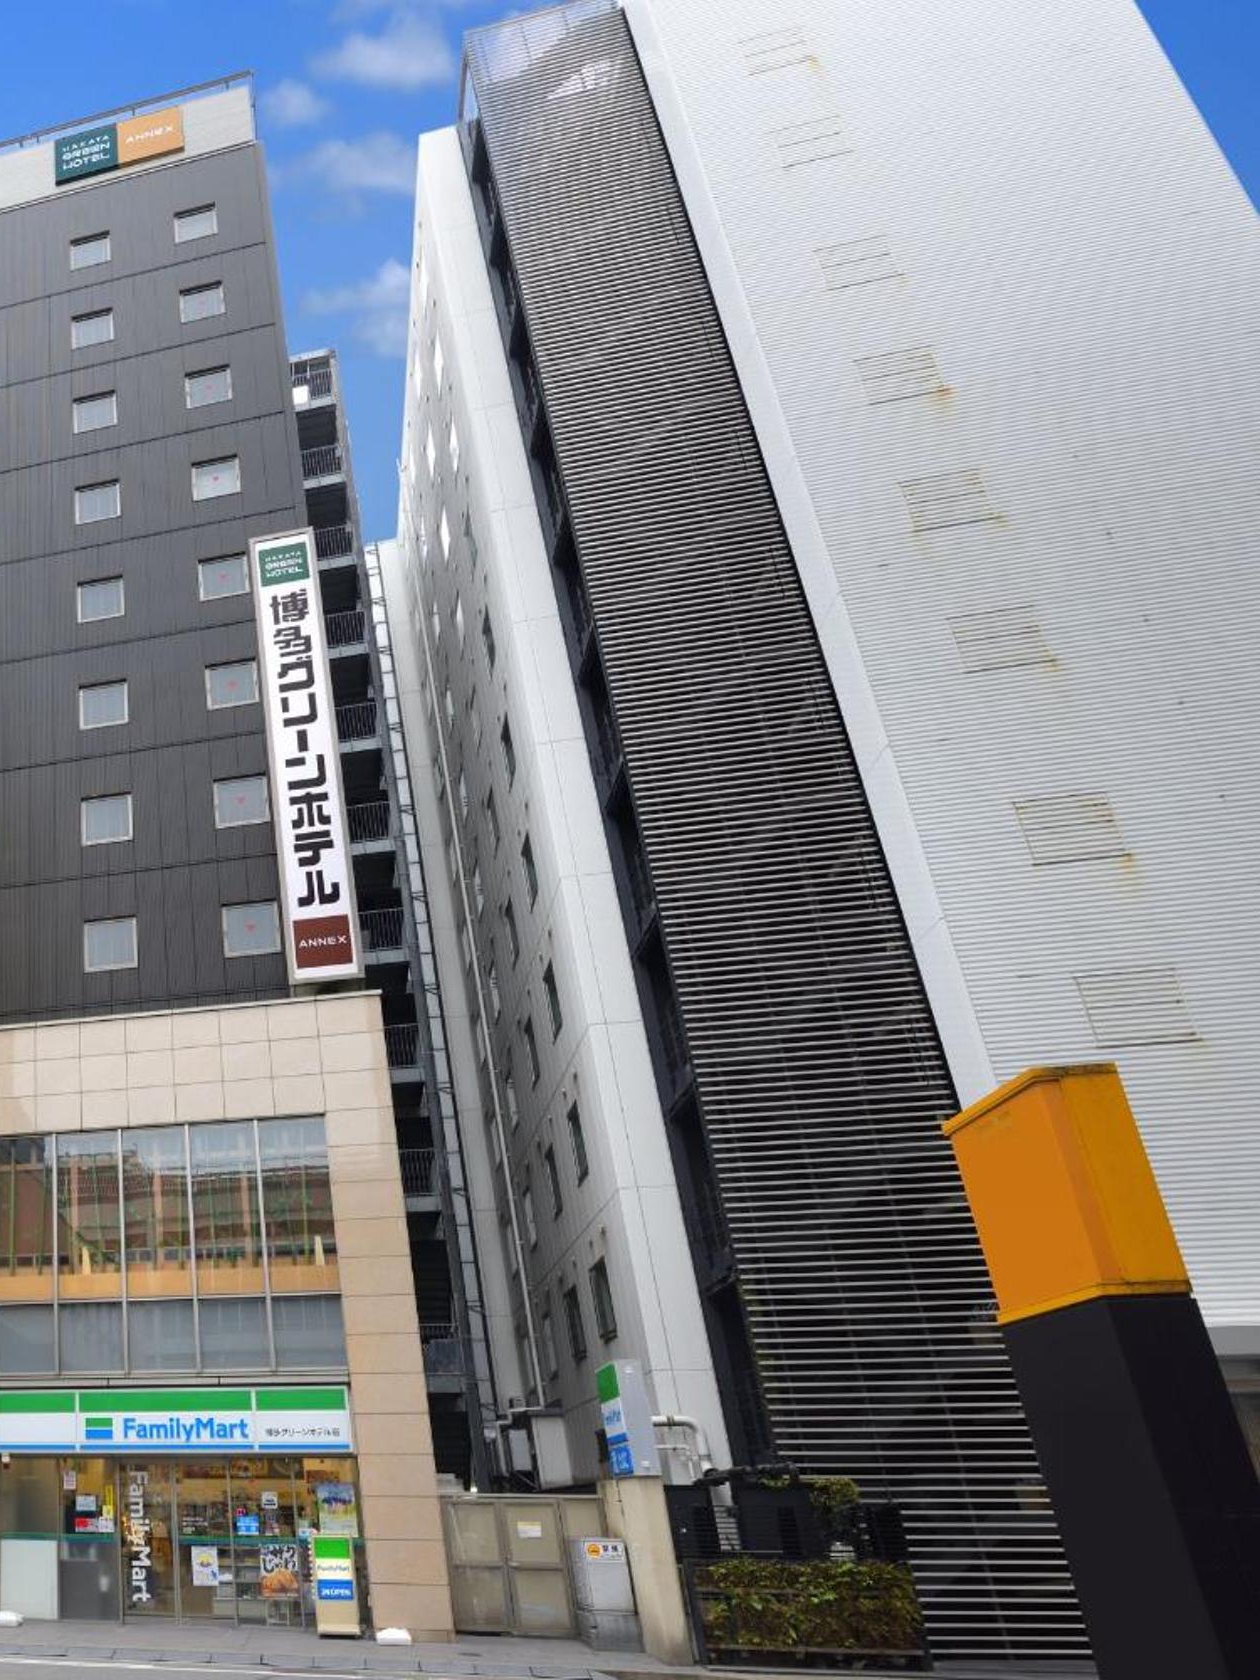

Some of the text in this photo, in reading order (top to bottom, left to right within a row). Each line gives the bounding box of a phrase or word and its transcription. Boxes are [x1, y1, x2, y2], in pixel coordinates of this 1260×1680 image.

[62, 135, 110, 152] HAKATA
[125, 124, 174, 144] ANNEX
[62, 141, 111, 161] GREEN
[62, 151, 111, 171] HOTEL
[269, 588, 340, 908] 博多グリーンホテル
[299, 935, 347, 949] ANNEX
[123, 1417, 249, 1442] FamilyMart
[130, 1471, 152, 1602] FamilyMart
